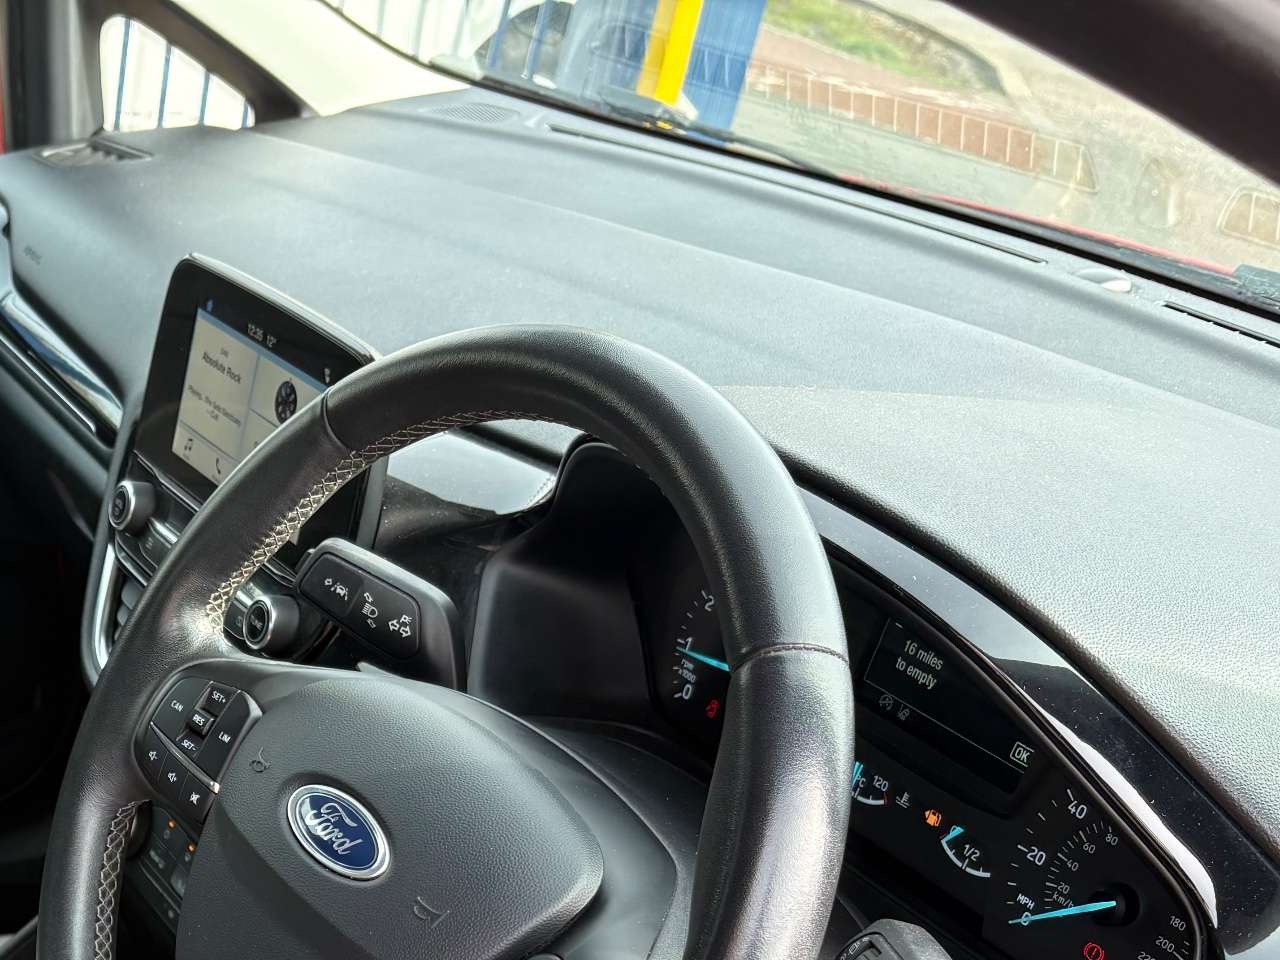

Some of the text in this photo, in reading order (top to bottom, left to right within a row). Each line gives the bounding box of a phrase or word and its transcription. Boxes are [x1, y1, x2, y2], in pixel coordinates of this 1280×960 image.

[904, 639, 944, 671] 16 miles
[895, 656, 937, 690] to empty
[211, 690, 227, 704] SET+
[170, 700, 184, 713] CAN
[192, 713, 206, 727] RES
[218, 731, 232, 744] LIM
[1014, 747, 1031, 763] OK
[873, 775, 889, 792] 120
[1067, 799, 1088, 820] 40
[304, 802, 364, 855] Ford
[1082, 842, 1096, 854] 60
[1105, 833, 1119, 847] 80
[962, 844, 981, 862] 1/2
[1026, 846, 1047, 866] 20
[1066, 860, 1080, 872] 40
[1057, 881, 1071, 894] 20
[1016, 893, 1036, 910] MPH
[1169, 915, 1187, 931] 180
[1155, 935, 1175, 953] 200
